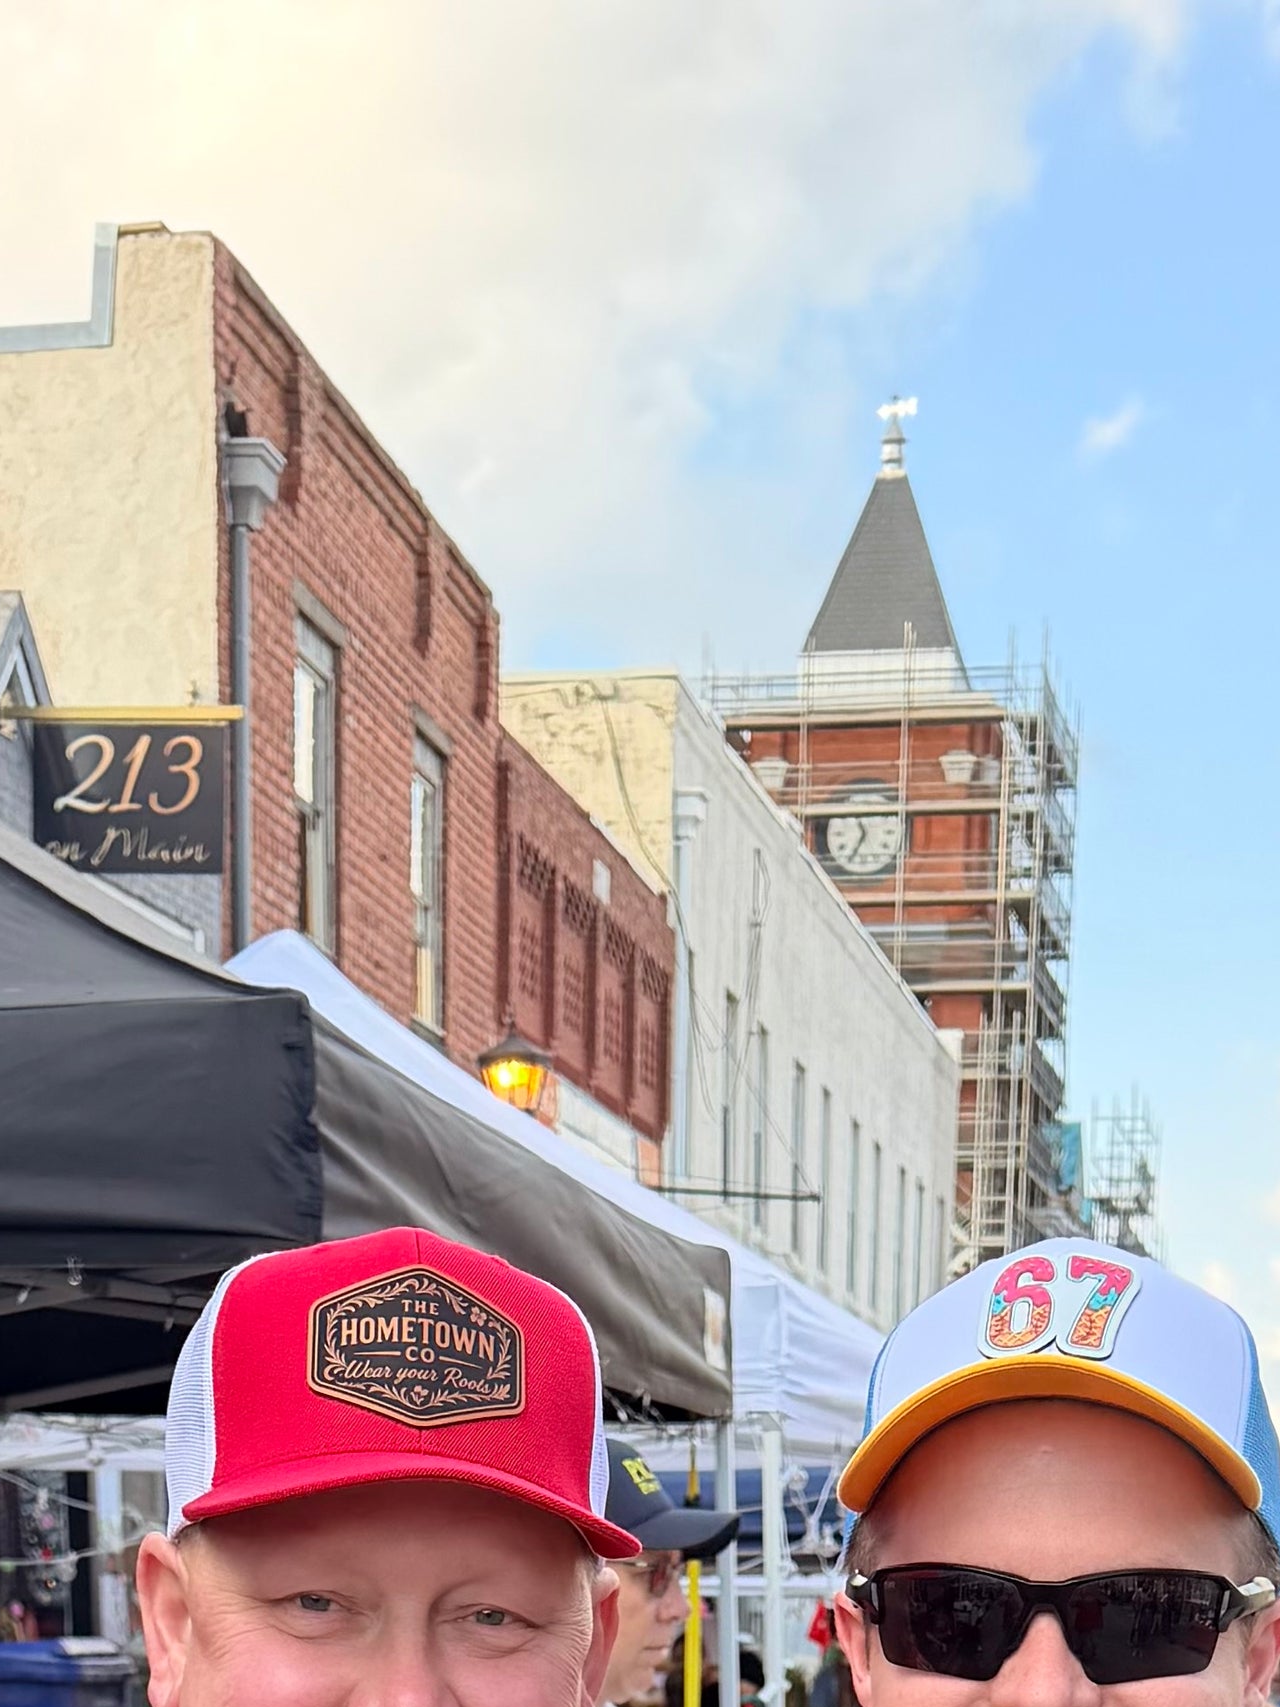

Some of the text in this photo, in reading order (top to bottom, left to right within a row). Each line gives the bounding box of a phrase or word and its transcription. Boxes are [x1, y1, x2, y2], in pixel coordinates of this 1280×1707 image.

[53, 734, 203, 815] 213
[401, 1300, 440, 1316] THE
[985, 1255, 1135, 1351] 67
[339, 1316, 496, 1362] HOMETOWN
[404, 1346, 436, 1364] CO
[343, 1359, 494, 1395] Wear your Roots
